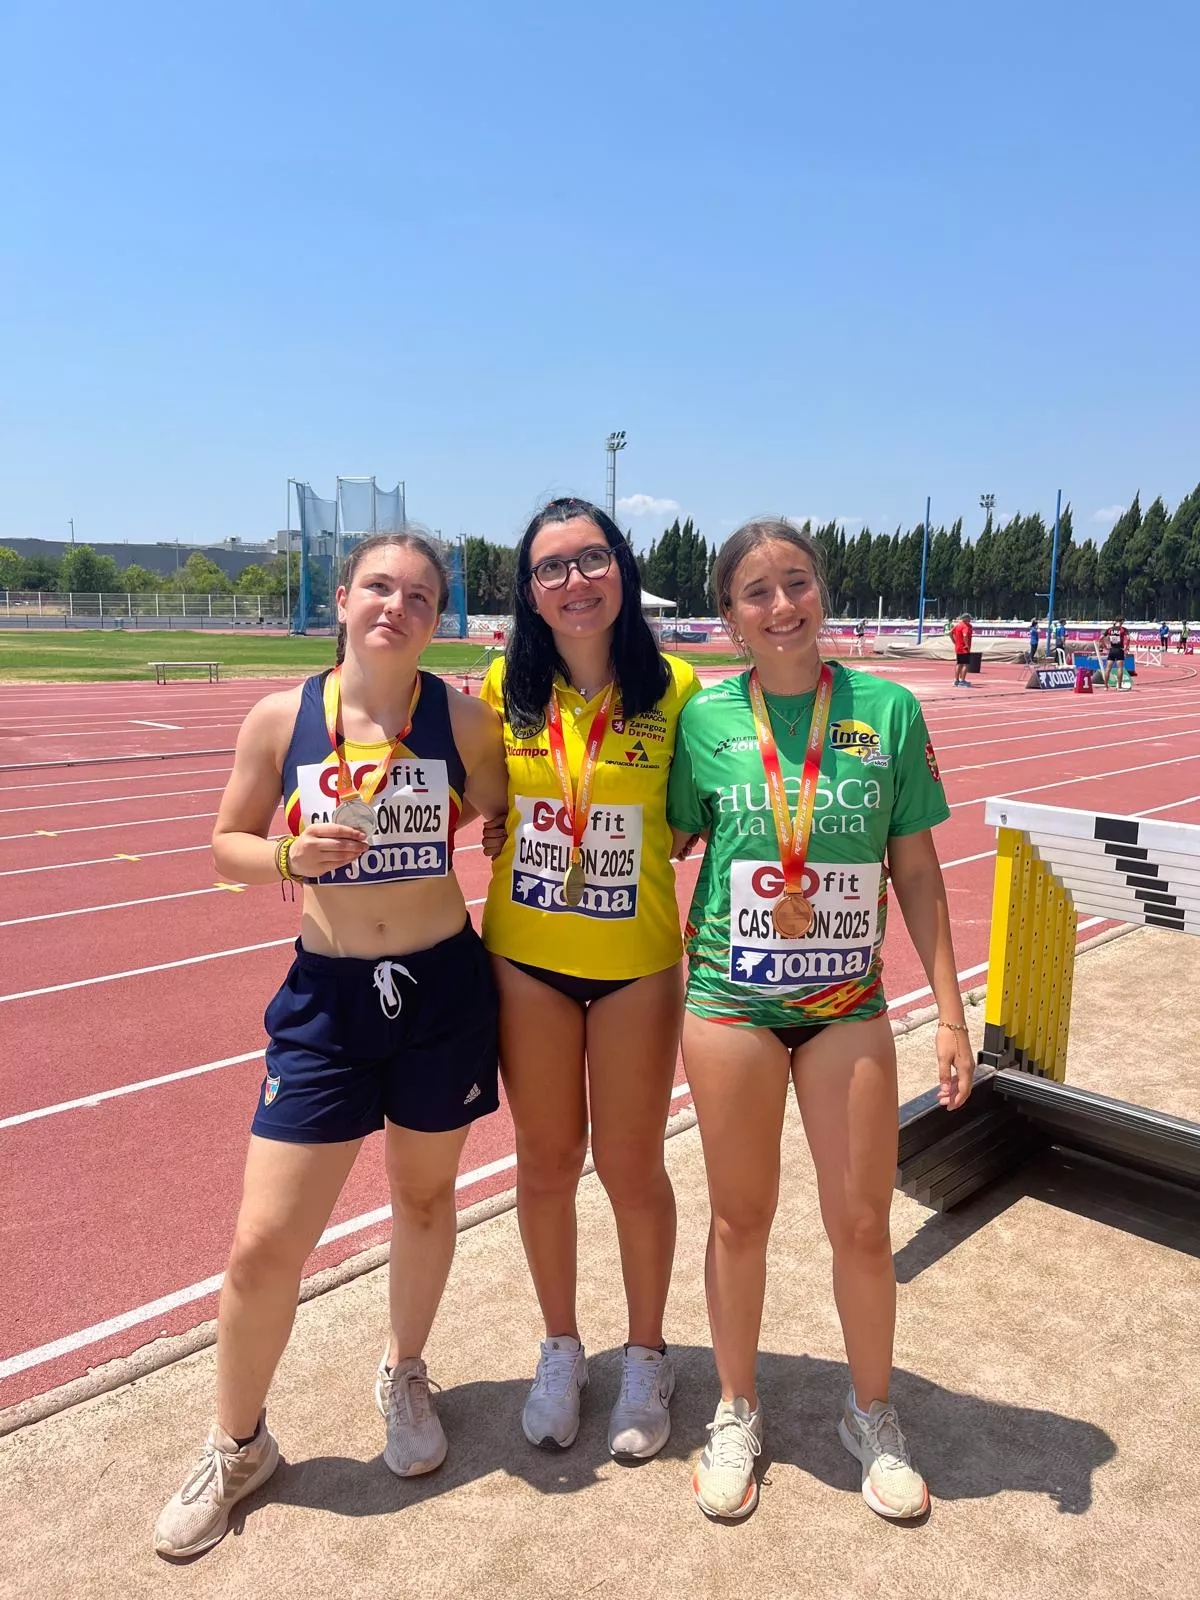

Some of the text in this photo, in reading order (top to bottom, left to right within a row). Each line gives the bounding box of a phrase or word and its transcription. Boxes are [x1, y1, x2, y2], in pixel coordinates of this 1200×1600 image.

[1047, 670, 1075, 687] Joma
[1083, 676, 1089, 689] 1
[629, 721, 667, 734] Zaragoza
[403, 804, 441, 834] 2025
[600, 849, 635, 877] 2025
[739, 903, 870, 940] CASÓN 2025
[765, 950, 866, 983] Joma
